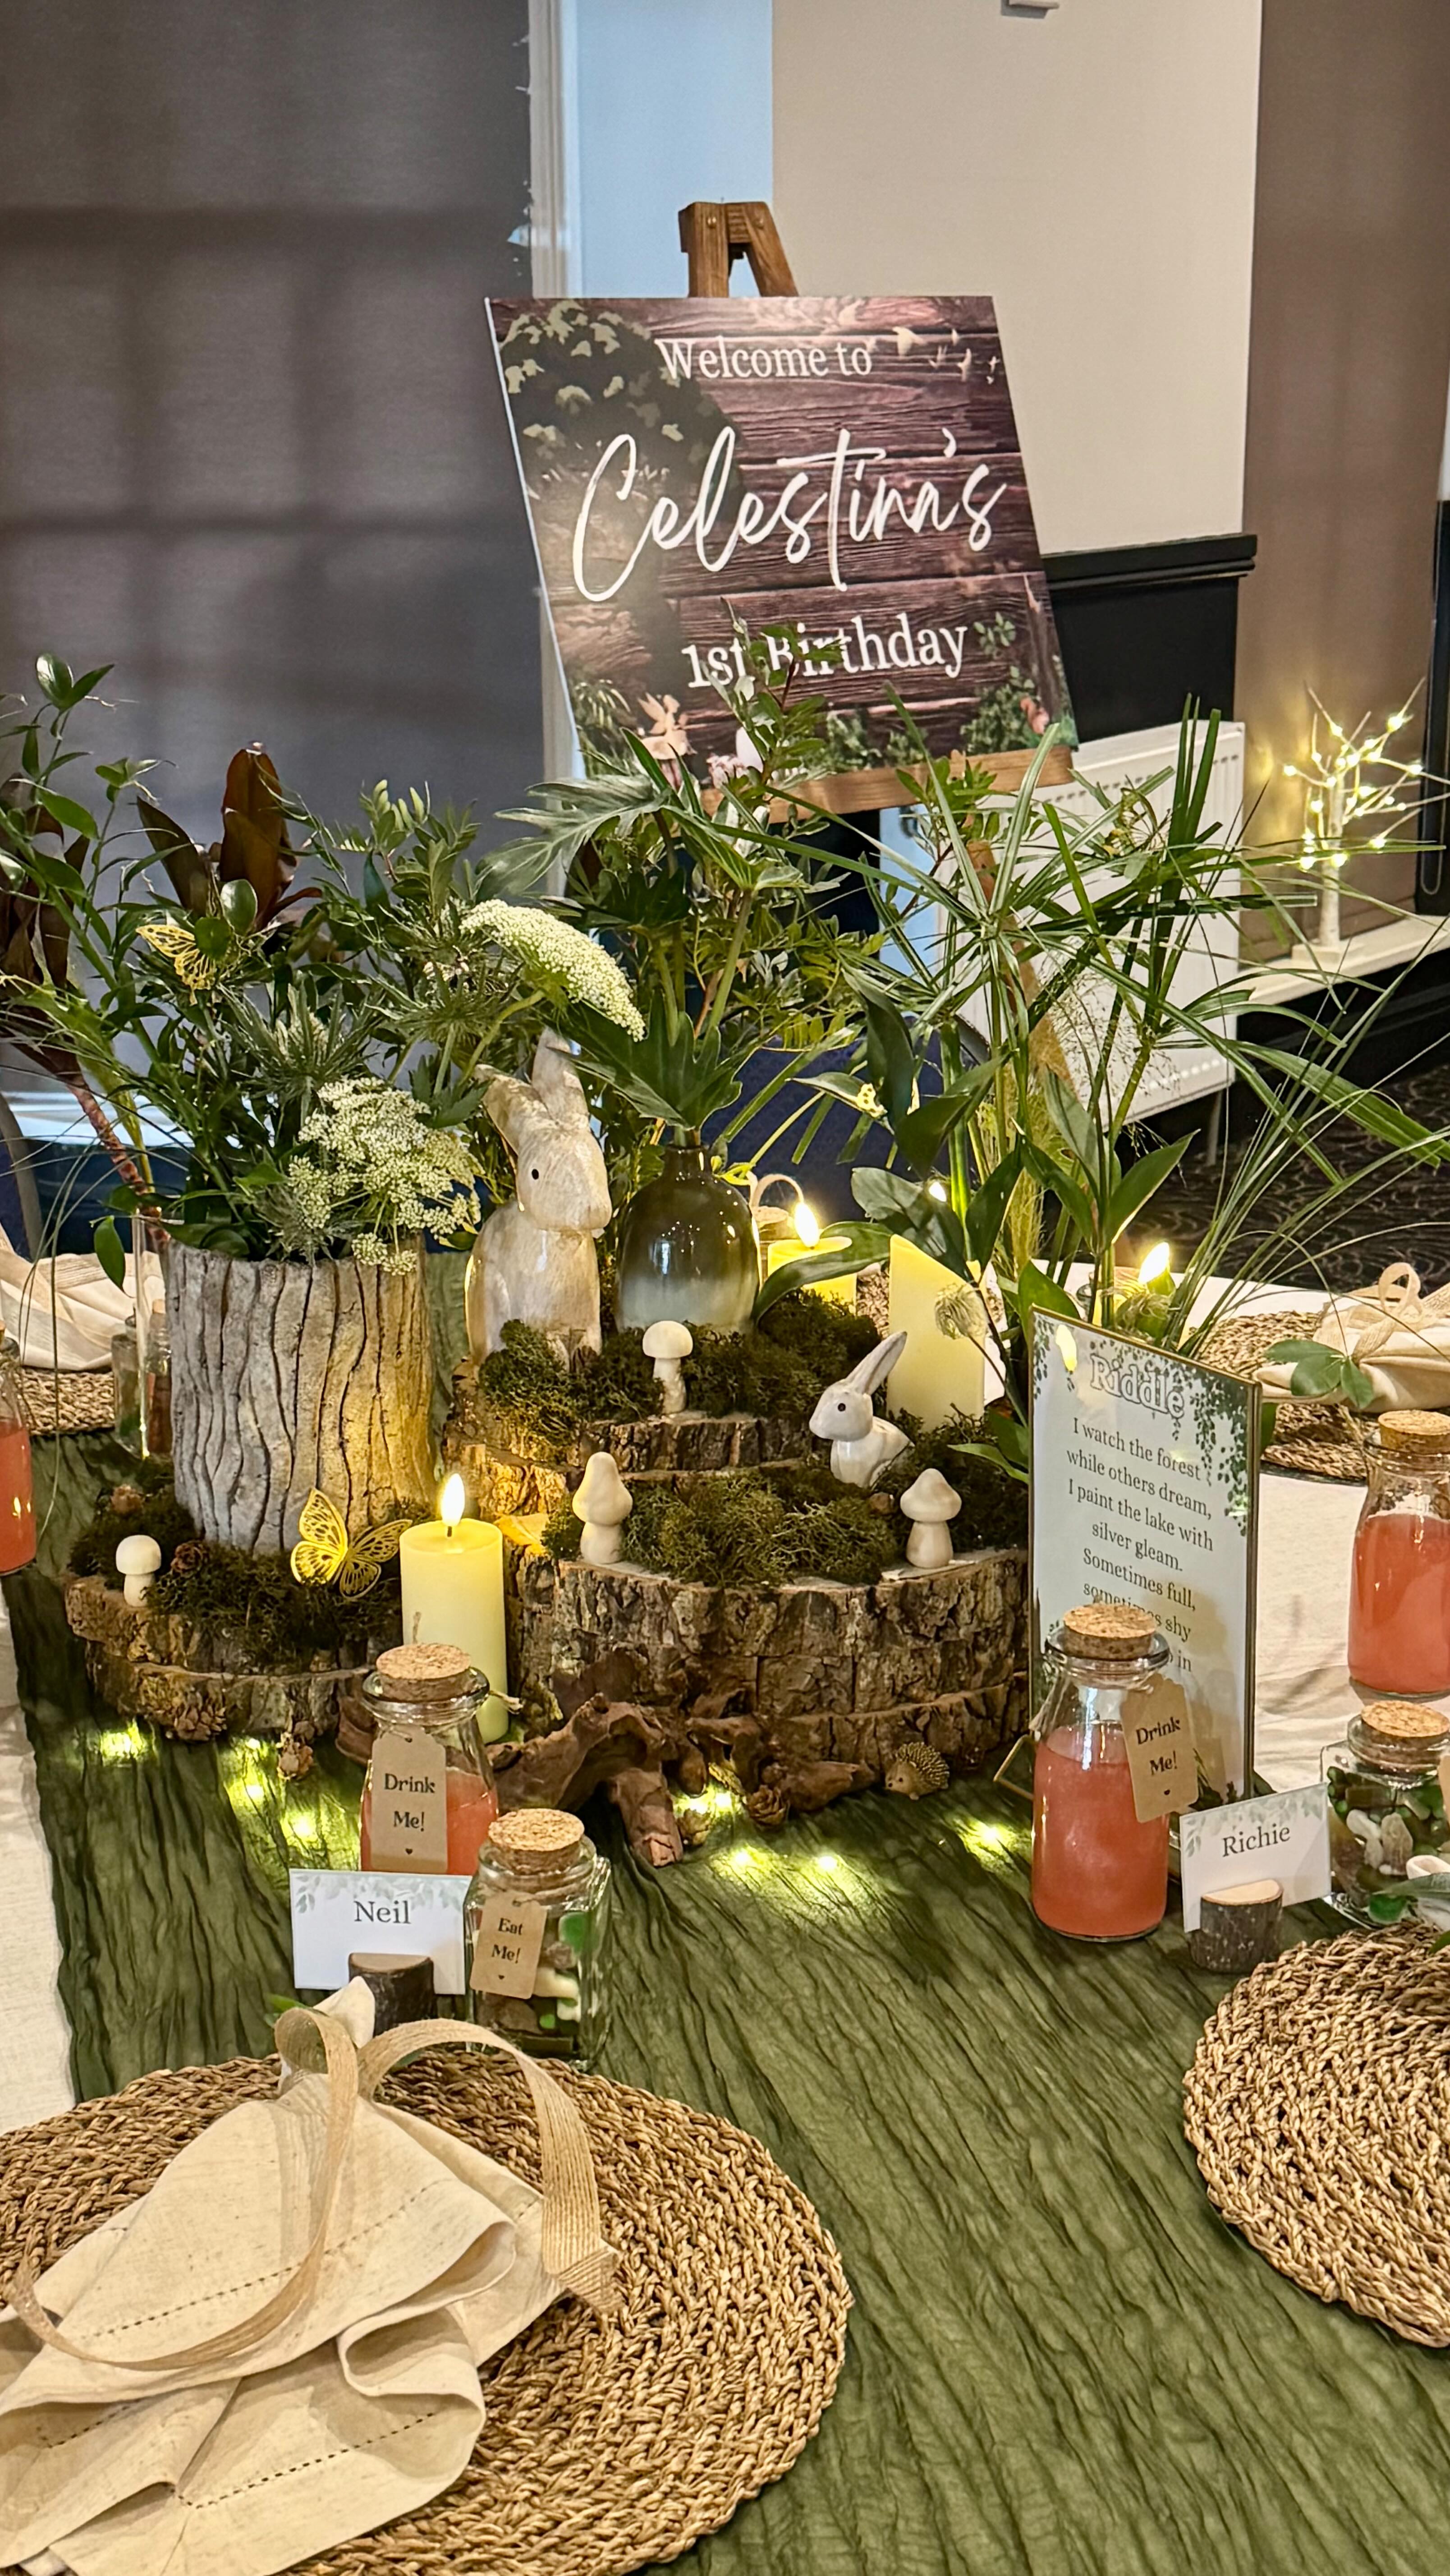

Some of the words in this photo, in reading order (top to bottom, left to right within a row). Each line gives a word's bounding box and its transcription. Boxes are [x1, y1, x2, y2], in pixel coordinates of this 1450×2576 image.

[654, 336, 829, 379] Welcome
[837, 342, 872, 376] to
[572, 426, 1007, 602] Celestina's
[681, 637, 756, 689] 1st
[760, 612, 968, 678] Birthday
[1090, 1352, 1184, 1419] Riddle
[1074, 1417, 1078, 1434] I
[1082, 1424, 1125, 1452] watch
[1129, 1438, 1153, 1462] the
[1157, 1447, 1201, 1481] forest
[1067, 1449, 1105, 1475] while
[1109, 1467, 1155, 1495] others
[1159, 1482, 1211, 1520] dream,
[1069, 1478, 1073, 1495] I
[1077, 1486, 1114, 1511] paint
[1118, 1499, 1141, 1522] the
[1146, 1507, 1175, 1536] lake
[1179, 1526, 1213, 1551] with
[1092, 1522, 1132, 1550] silver
[1135, 1538, 1183, 1572] gleam.
[1083, 1548, 1163, 1596] Sometimes
[1168, 1581, 1196, 1611] full,
[1165, 1615, 1191, 1642] shy
[1178, 1650, 1191, 1672] in
[1136, 1716, 1181, 1745] Drink
[1150, 1750, 1178, 1776] Me!
[385, 1773, 436, 1794] Drink
[394, 1811, 425, 1832] Me!
[1222, 1823, 1291, 1857] Richie
[353, 1900, 411, 1925] Neil
[498, 1918, 523, 1936] Eat
[491, 1944, 521, 1964] Me!
